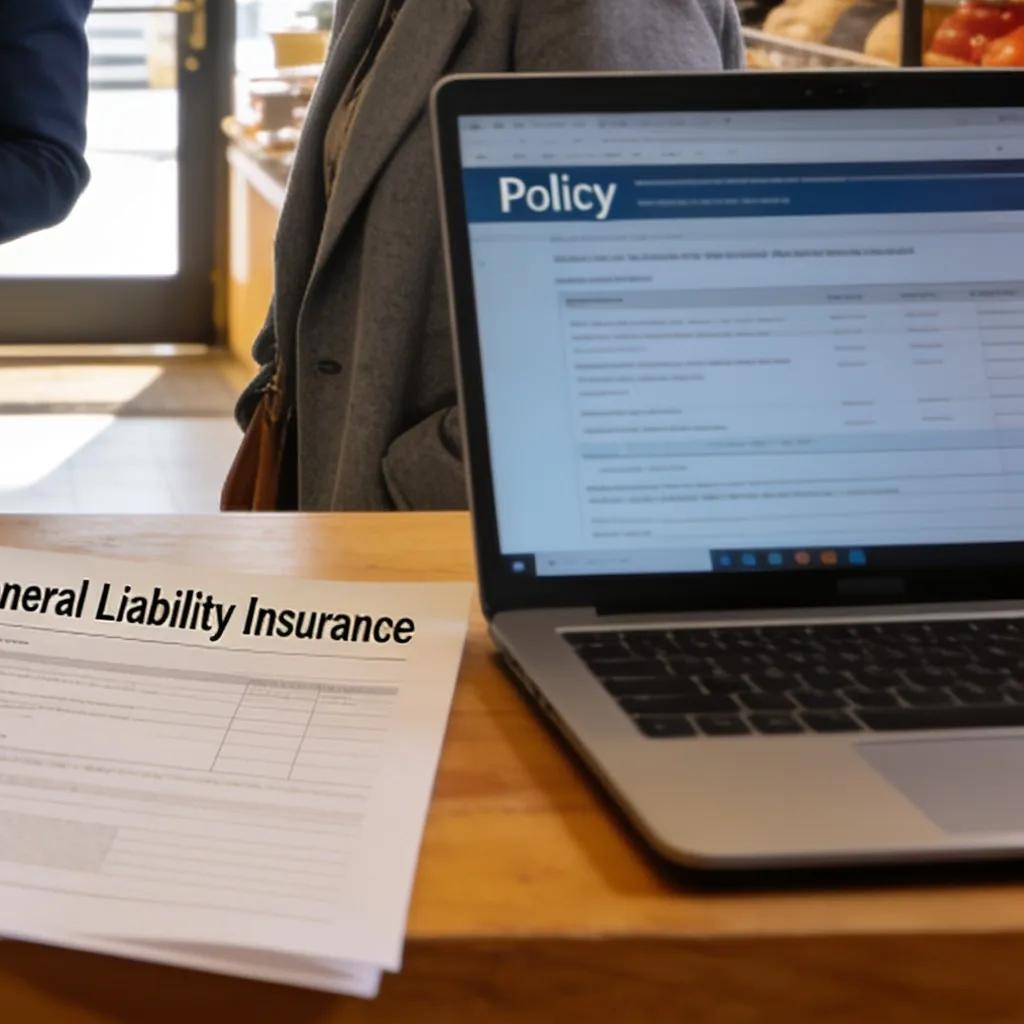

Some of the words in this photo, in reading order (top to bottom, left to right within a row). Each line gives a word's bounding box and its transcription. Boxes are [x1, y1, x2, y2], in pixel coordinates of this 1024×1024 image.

[498, 173, 617, 220] Policy
[95, 583, 237, 642] Liability
[242, 596, 415, 644] Insurance
